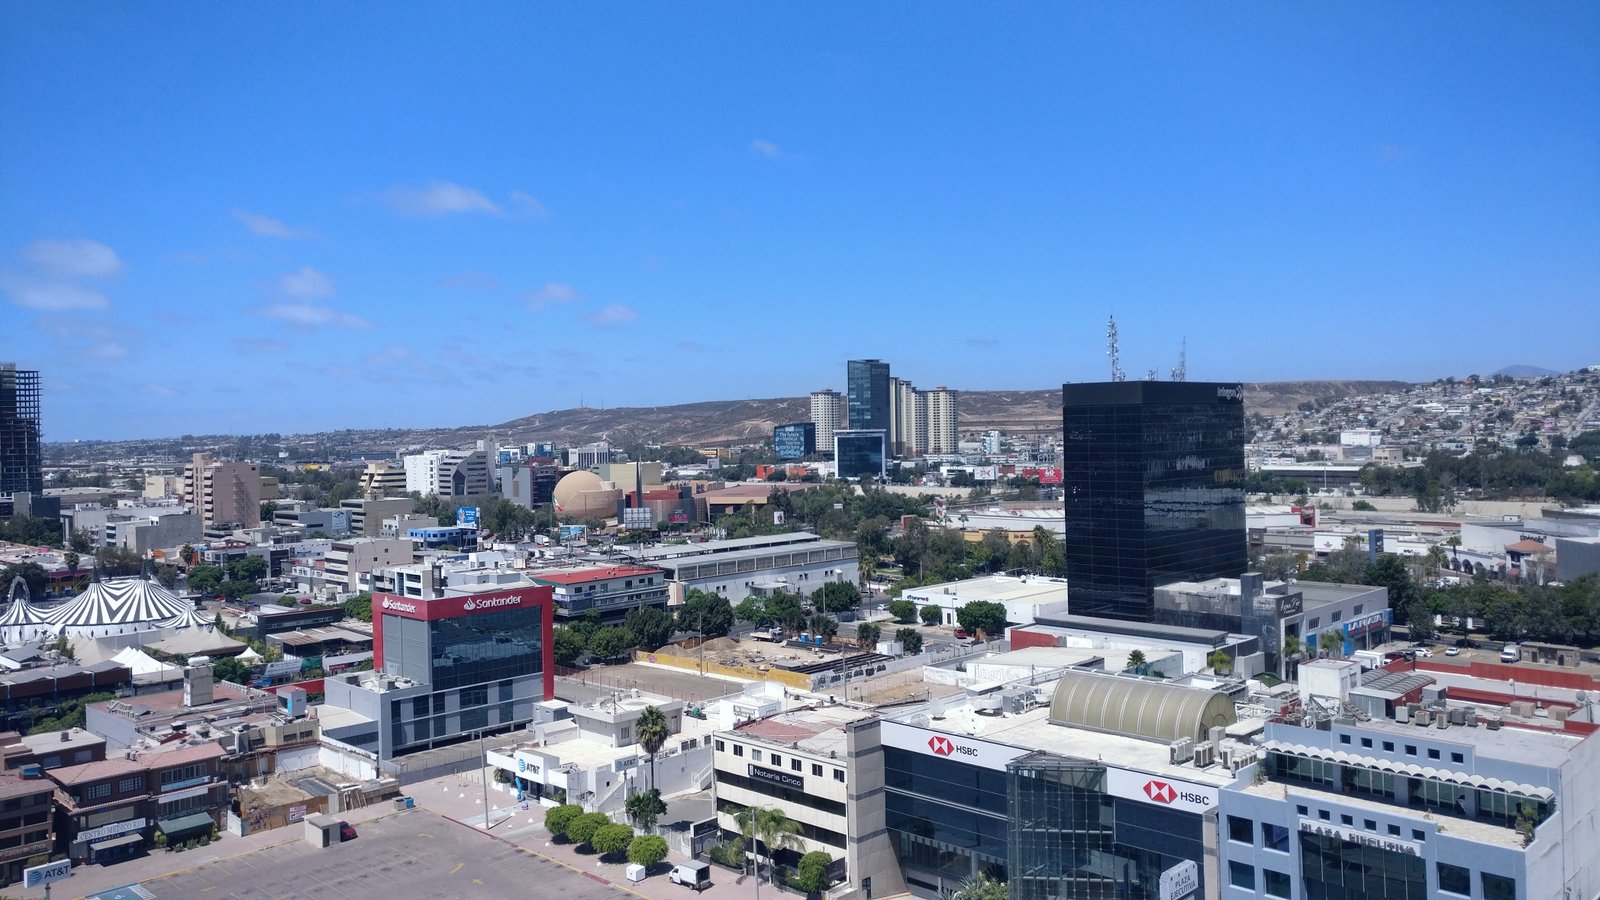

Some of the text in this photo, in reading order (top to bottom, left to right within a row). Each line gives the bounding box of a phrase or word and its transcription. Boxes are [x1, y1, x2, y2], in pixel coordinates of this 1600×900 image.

[388, 599, 416, 613] Santander
[476, 595, 522, 609] Santander
[956, 745, 978, 757] HSBC
[526, 763, 540, 775] AT&T
[781, 775, 801, 787] Cinco
[1180, 791, 1209, 806] HSBC
[80, 827, 106, 841] CENTRO
[45, 865, 69, 879] AT&T
[1175, 874, 1191, 888] PLAZA
